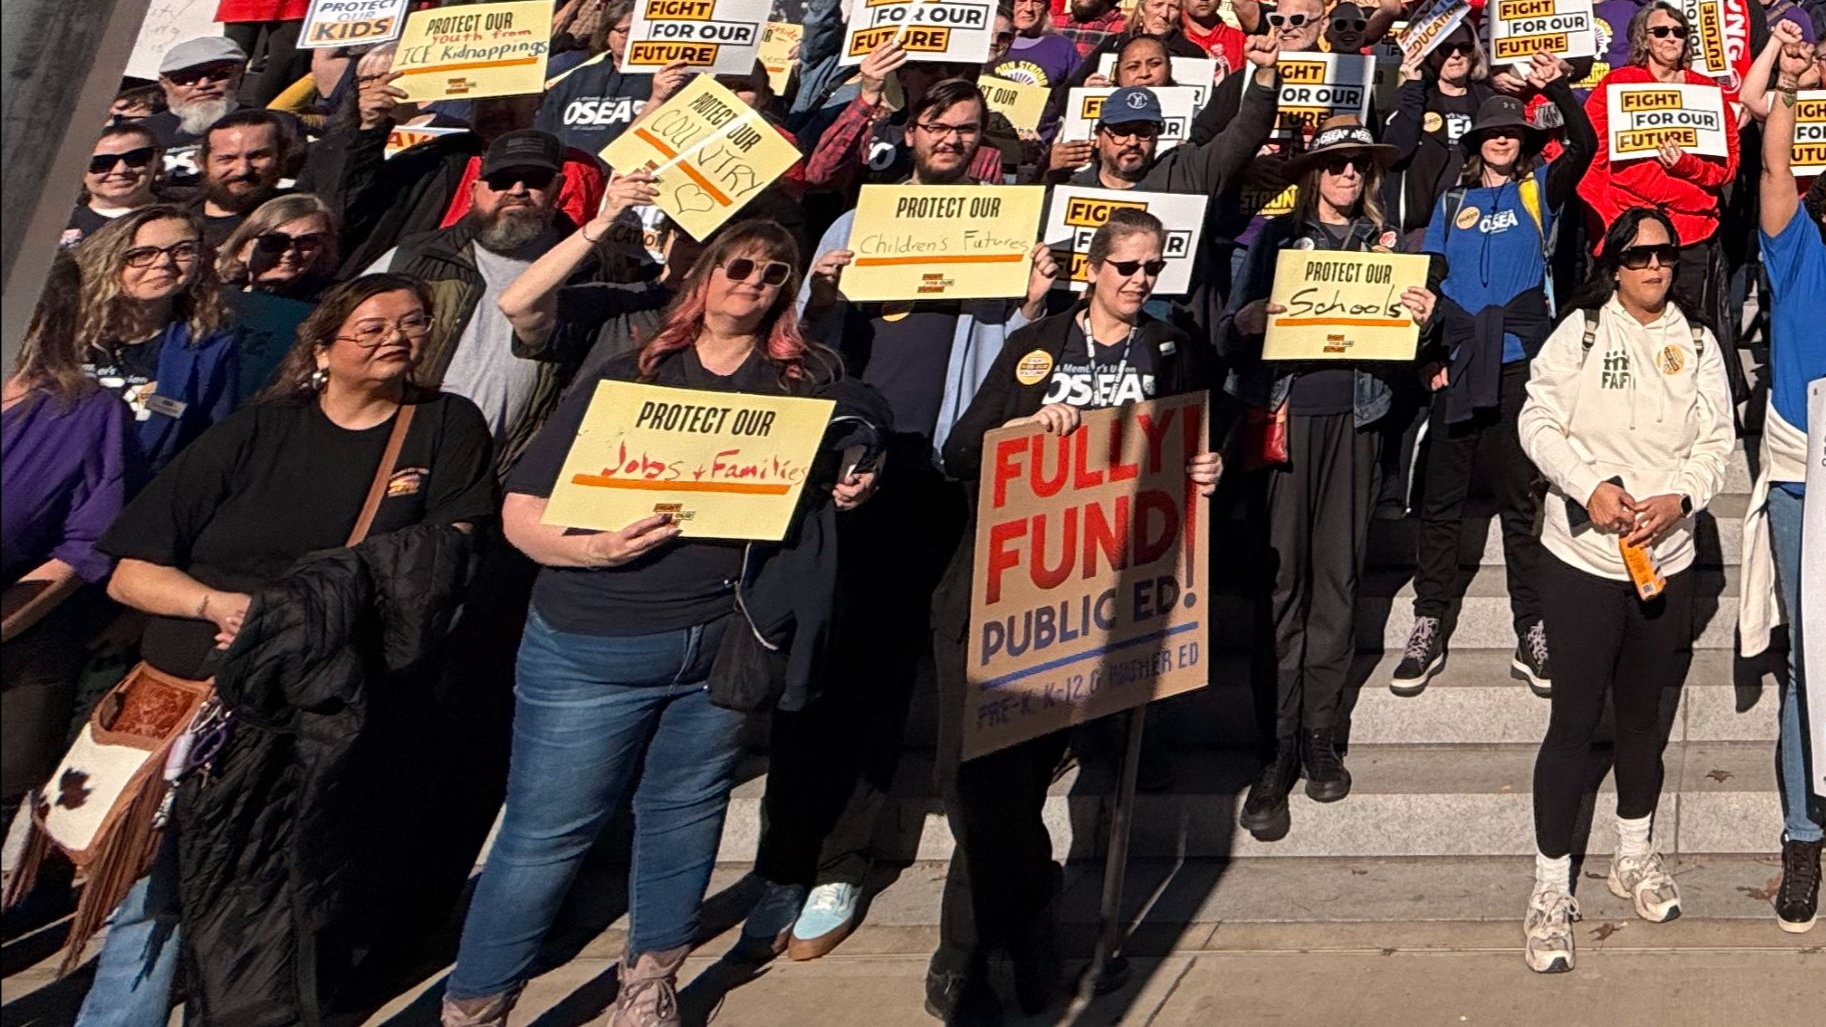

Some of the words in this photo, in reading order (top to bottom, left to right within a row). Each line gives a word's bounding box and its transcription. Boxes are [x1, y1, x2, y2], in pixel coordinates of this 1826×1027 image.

[337, 11, 376, 21] OUR
[648, 0, 711, 18] FIGHT
[315, 18, 390, 40] KIDS
[427, 13, 481, 36] PROTECT
[485, 12, 513, 32] OUR
[652, 23, 696, 39] FOR
[699, 24, 750, 42] OUR
[432, 33, 483, 46] youth
[492, 29, 532, 39] from
[401, 44, 431, 66] ICE
[440, 39, 548, 62] Kidnappings
[632, 44, 711, 63] FUTURE
[563, 100, 634, 126] OSEA
[895, 197, 965, 219] PROTECT
[969, 197, 1001, 218] OUR
[1479, 212, 1519, 233] OSEA
[859, 233, 948, 255] Children's
[962, 230, 1030, 253] Futures
[1305, 261, 1363, 283] PROTECT
[1367, 264, 1393, 284] OUR
[1289, 285, 1402, 319] Schools
[634, 400, 729, 436] PROTECT
[735, 407, 777, 437] OUR
[600, 440, 684, 481] Jobs
[709, 444, 811, 485] Families
[990, 409, 1172, 509] FULLY
[984, 488, 1180, 607] FUND
[980, 589, 1117, 668] PUBLIC
